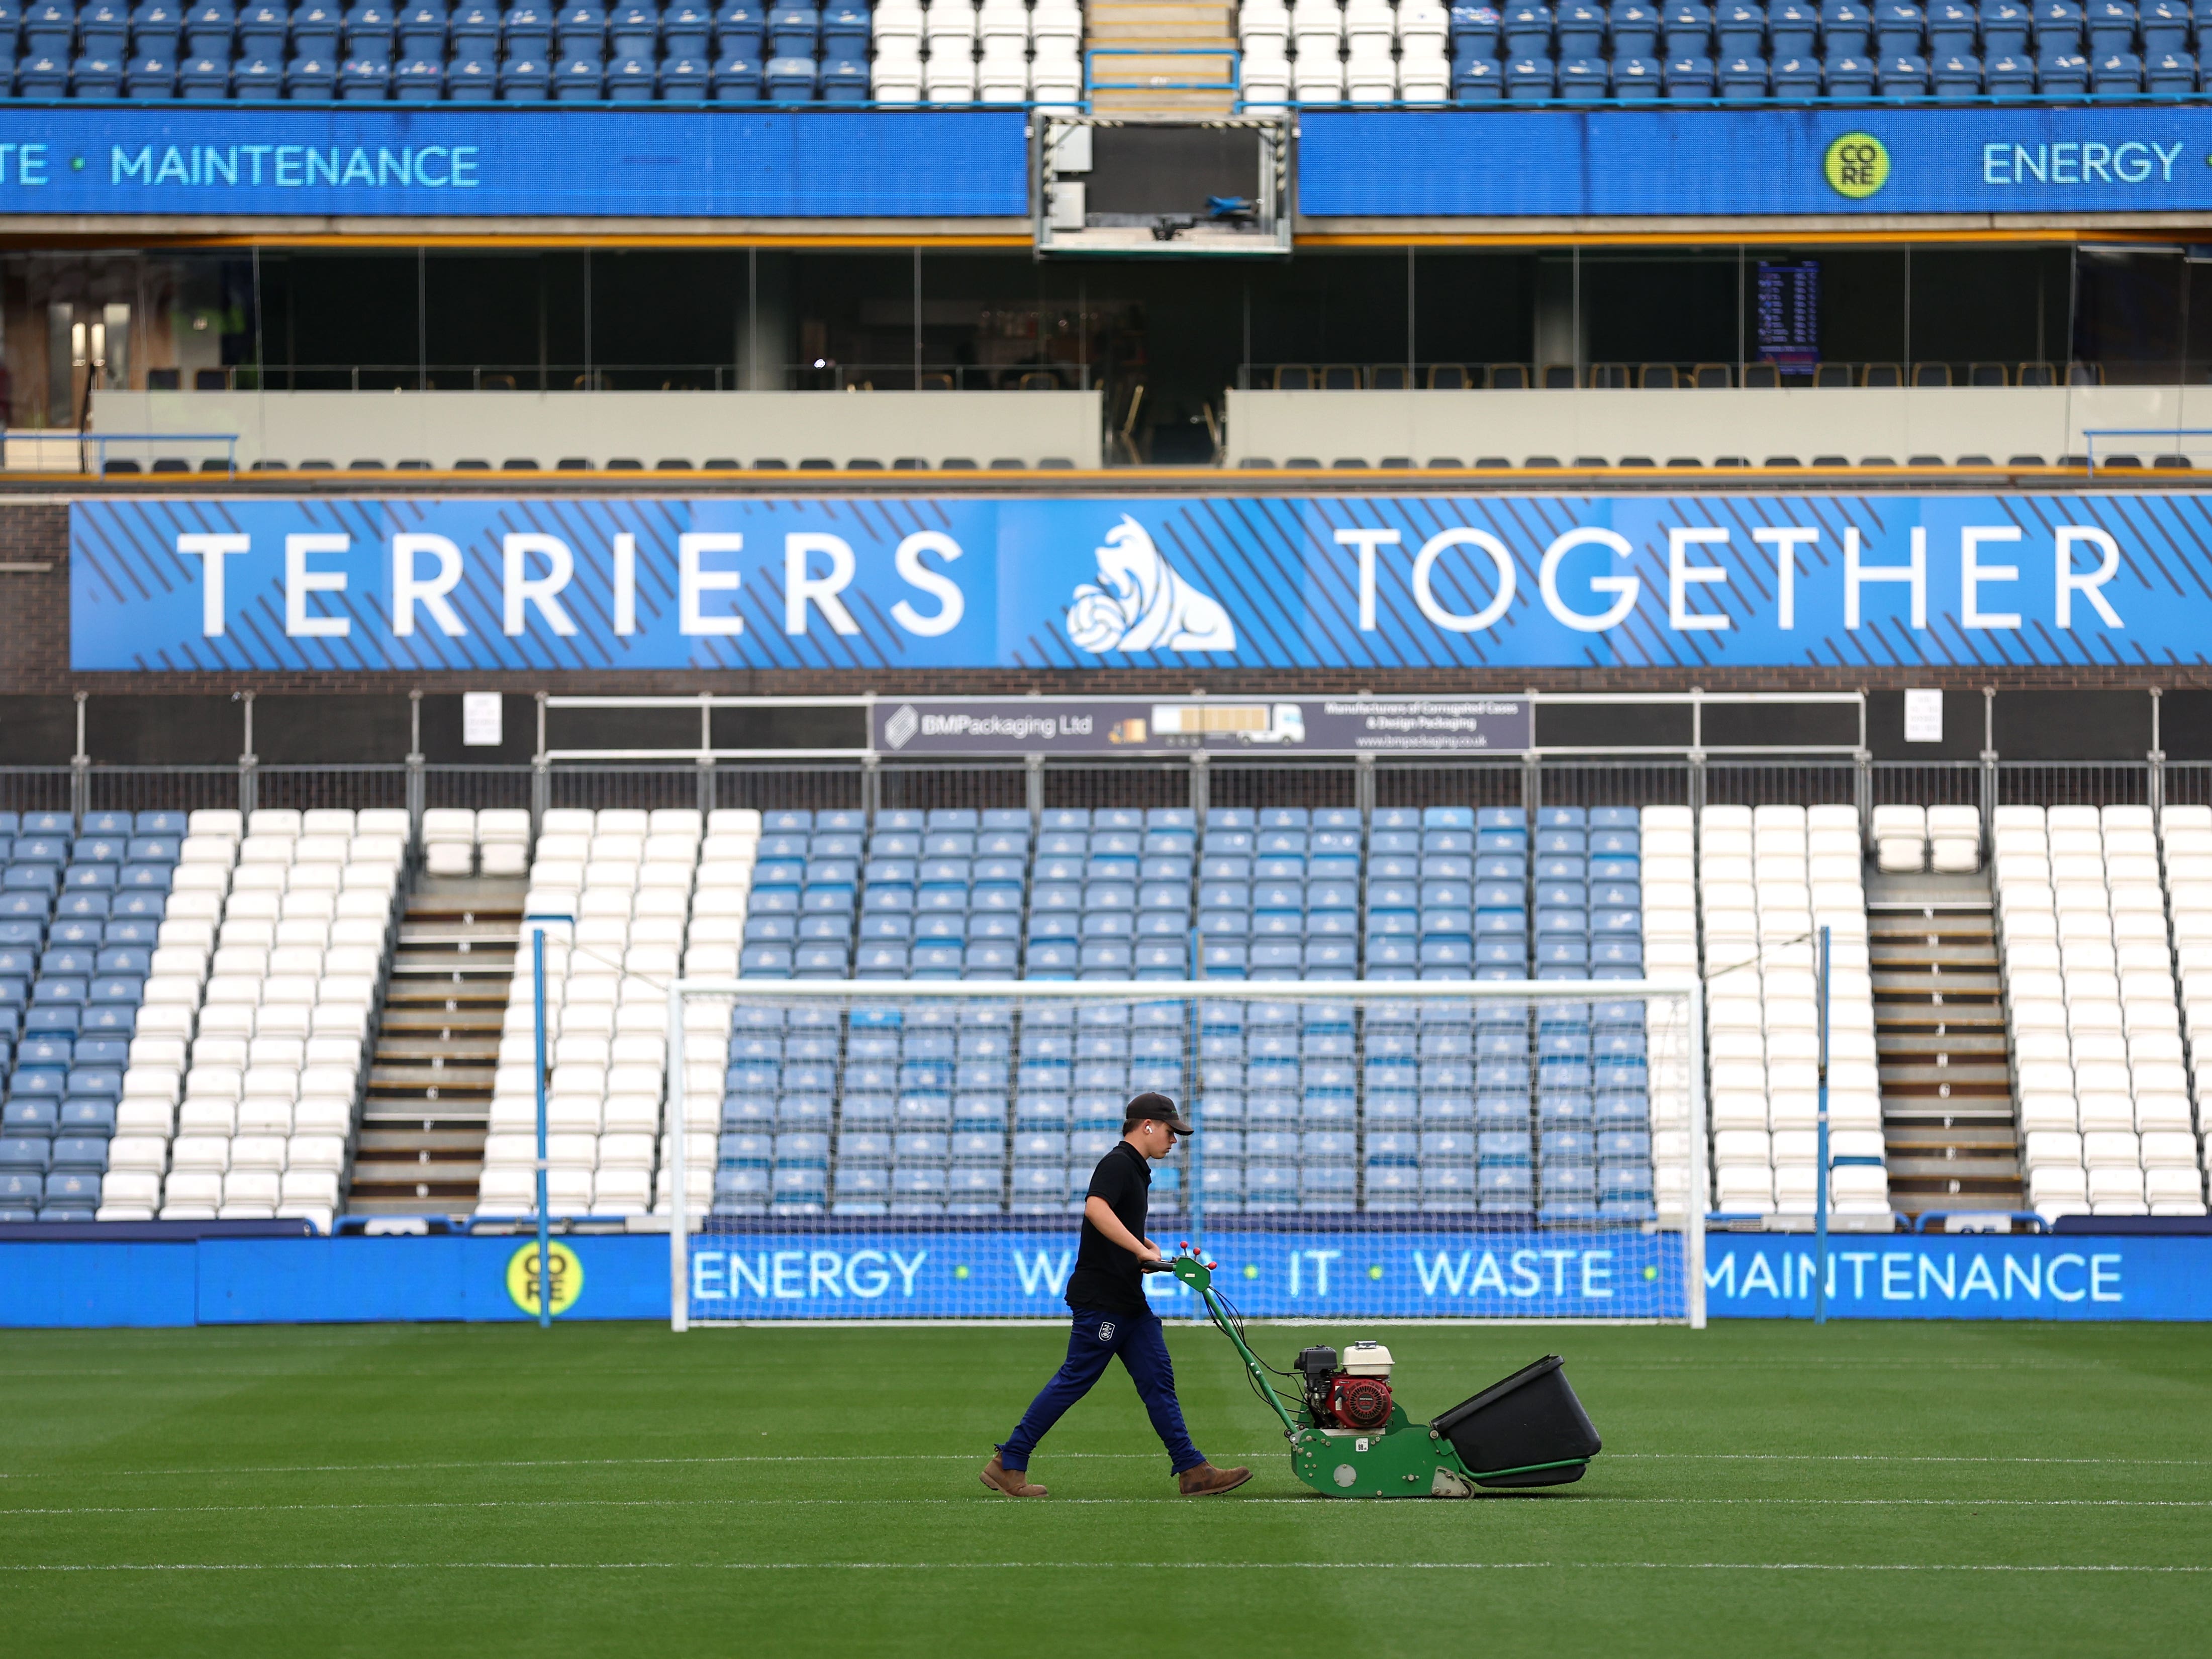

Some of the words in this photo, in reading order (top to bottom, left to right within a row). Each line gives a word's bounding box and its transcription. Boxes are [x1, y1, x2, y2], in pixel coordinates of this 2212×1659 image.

[111, 144, 480, 186] MAINTENANCE
[1840, 144, 1875, 162] CO
[1983, 141, 2184, 184] ENERGY
[1842, 166, 1874, 184] RE
[176, 530, 965, 637] TERRIERS
[1333, 526, 2126, 633] TOGETHER
[921, 714, 1056, 739] BMPackaging
[1059, 714, 1093, 735] Ltd
[693, 1249, 928, 1299] ENERGY
[1288, 1249, 1342, 1298] IT
[1413, 1249, 1614, 1298] WASTE
[1703, 1250, 2123, 1302] MAINTENANCE
